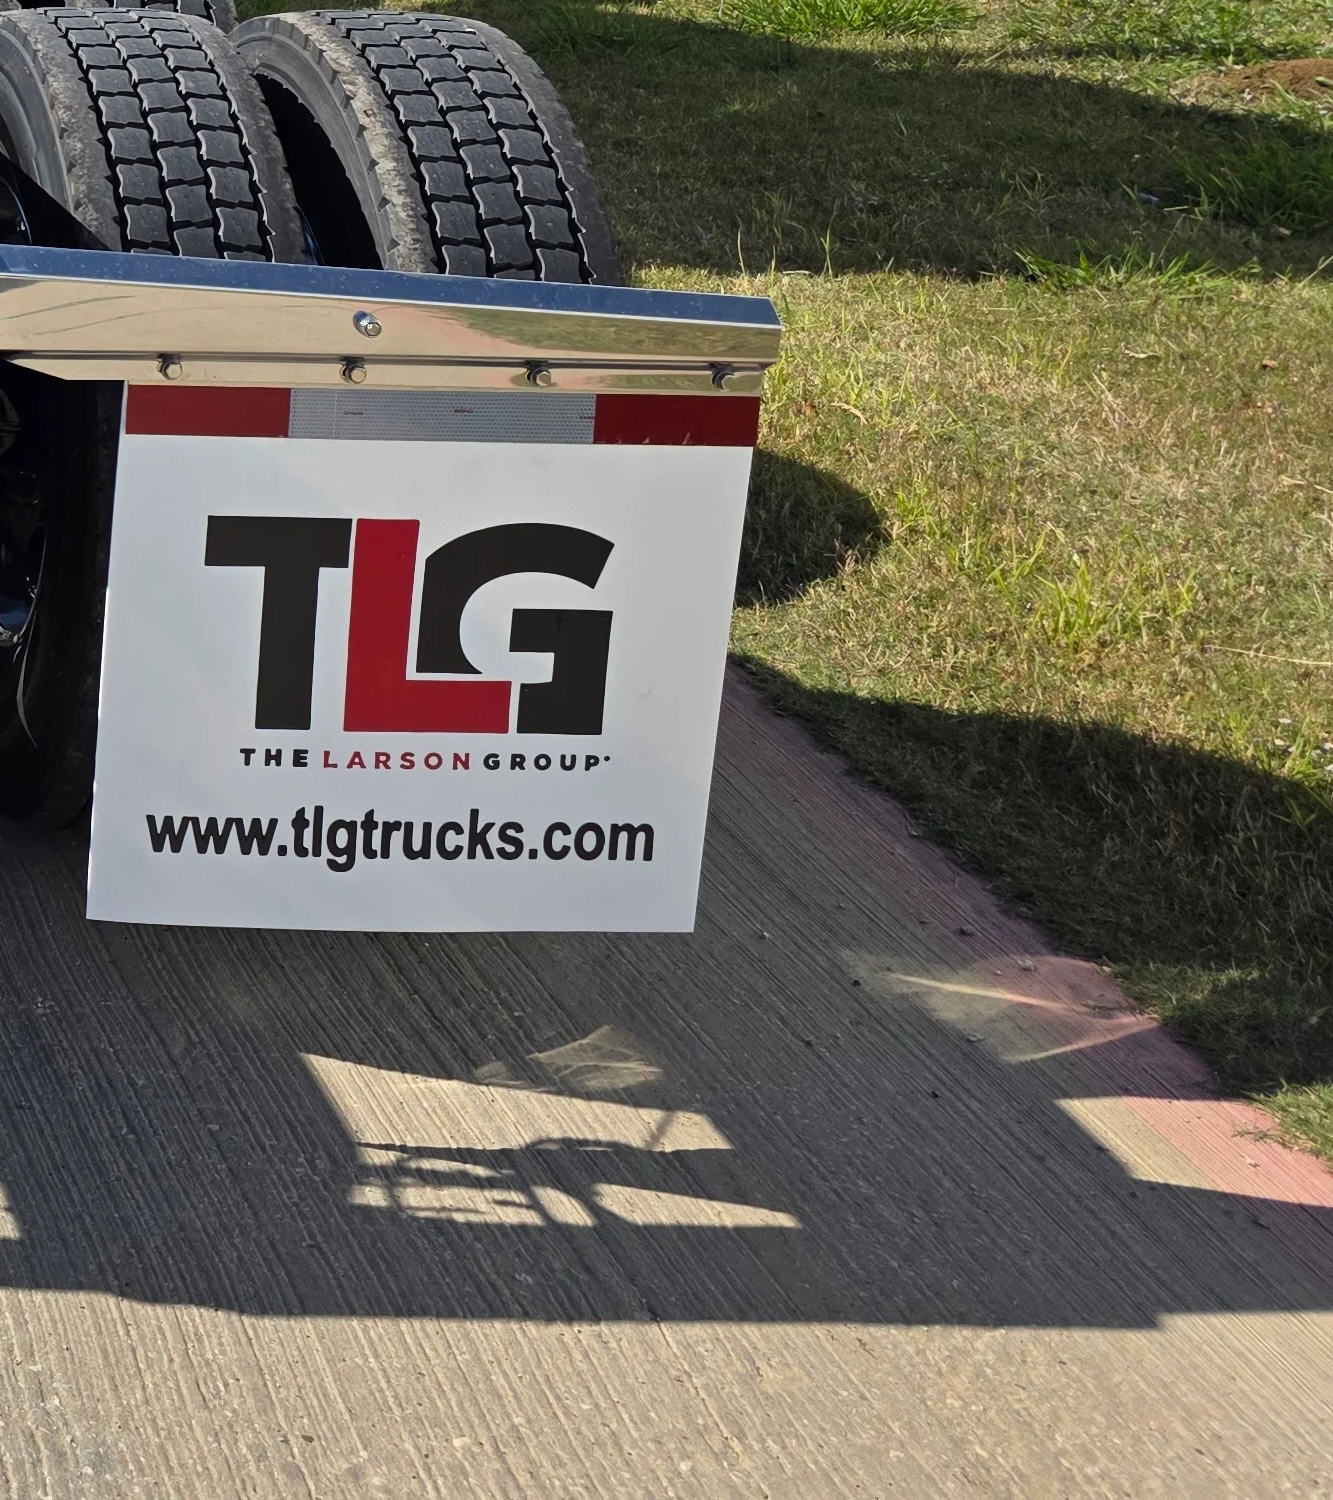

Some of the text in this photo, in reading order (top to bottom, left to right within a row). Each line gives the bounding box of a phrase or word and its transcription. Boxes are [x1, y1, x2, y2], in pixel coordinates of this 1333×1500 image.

[204, 515, 615, 735] TLG
[240, 748, 600, 771] THE LARSON GROUP
[146, 806, 654, 872] www.tlgtrucks.com
